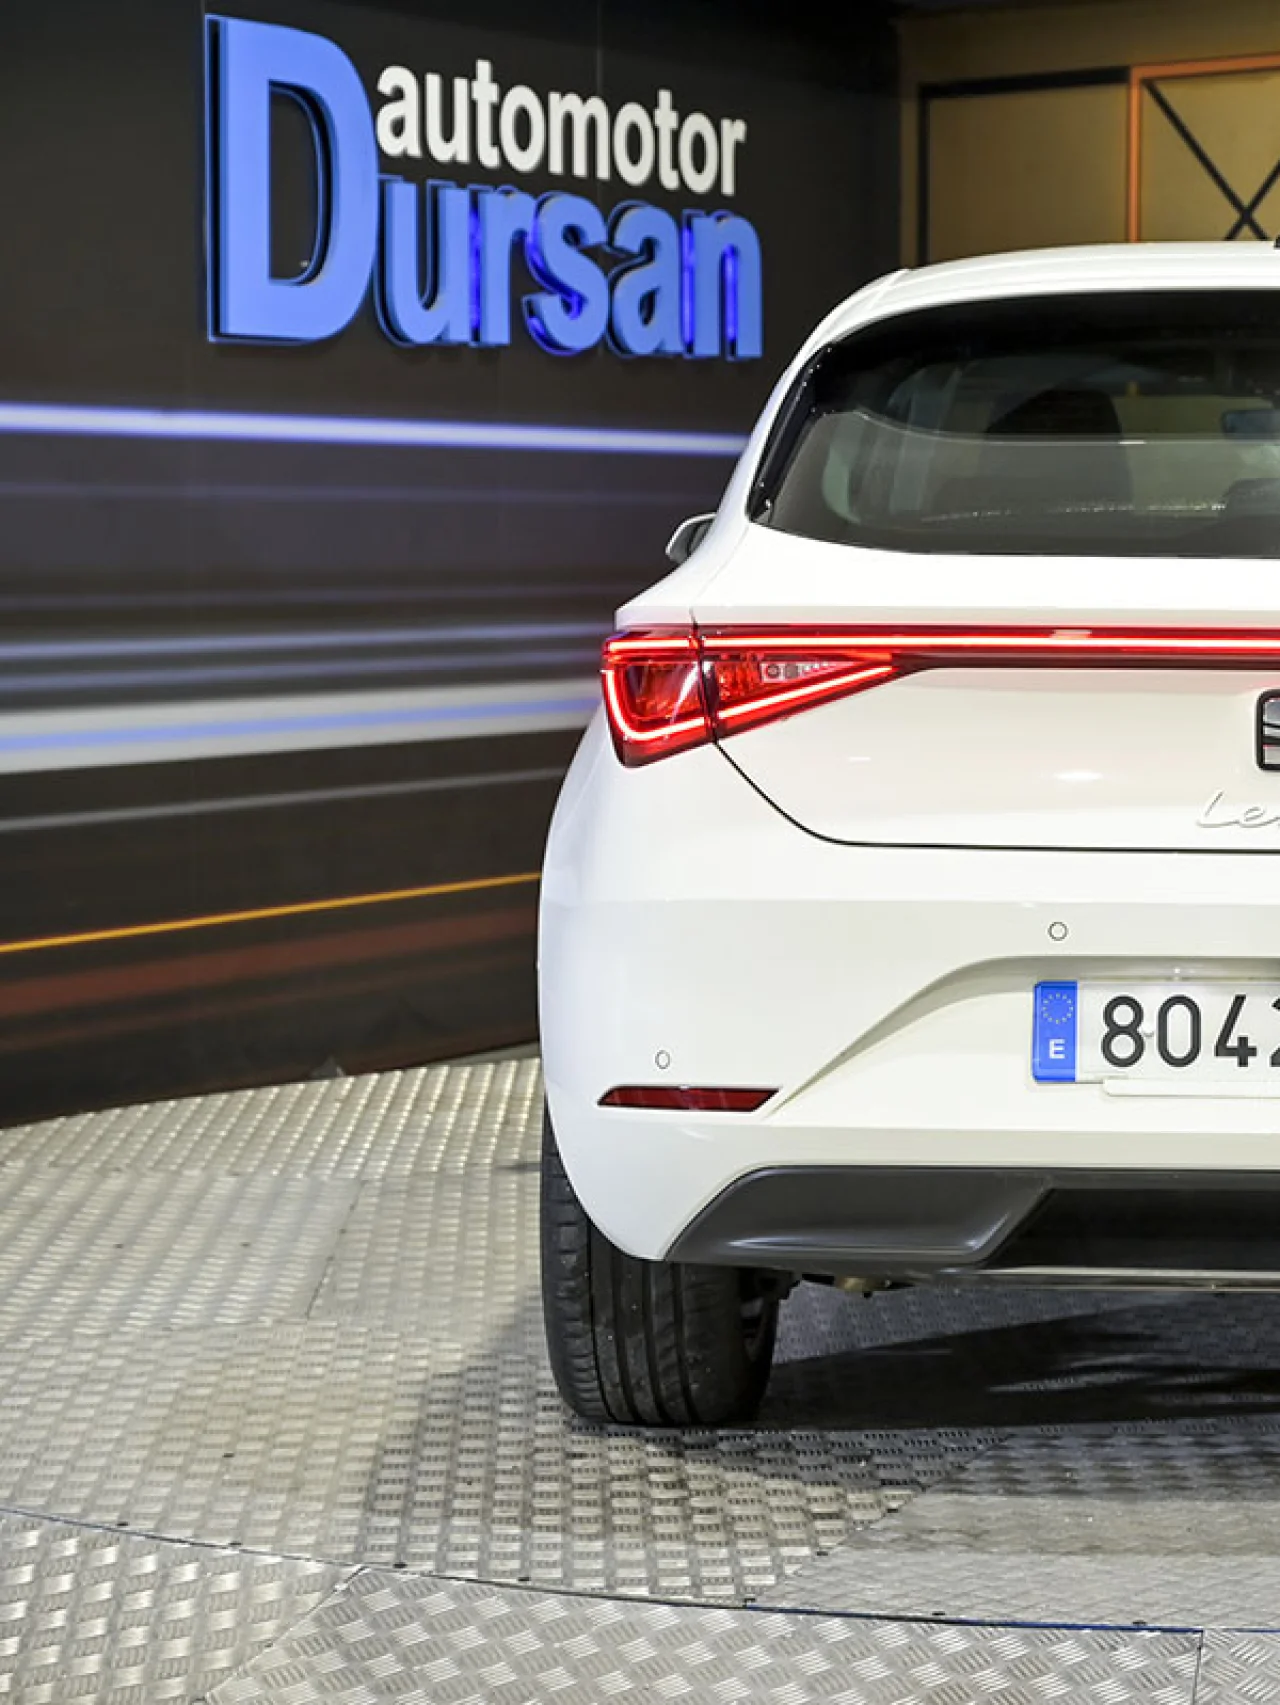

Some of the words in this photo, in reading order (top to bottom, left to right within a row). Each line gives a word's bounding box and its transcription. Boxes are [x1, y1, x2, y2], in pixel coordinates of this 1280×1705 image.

[204, 14, 763, 362] Dursan
[376, 60, 746, 195] automotor
[1048, 1040, 1066, 1059] E
